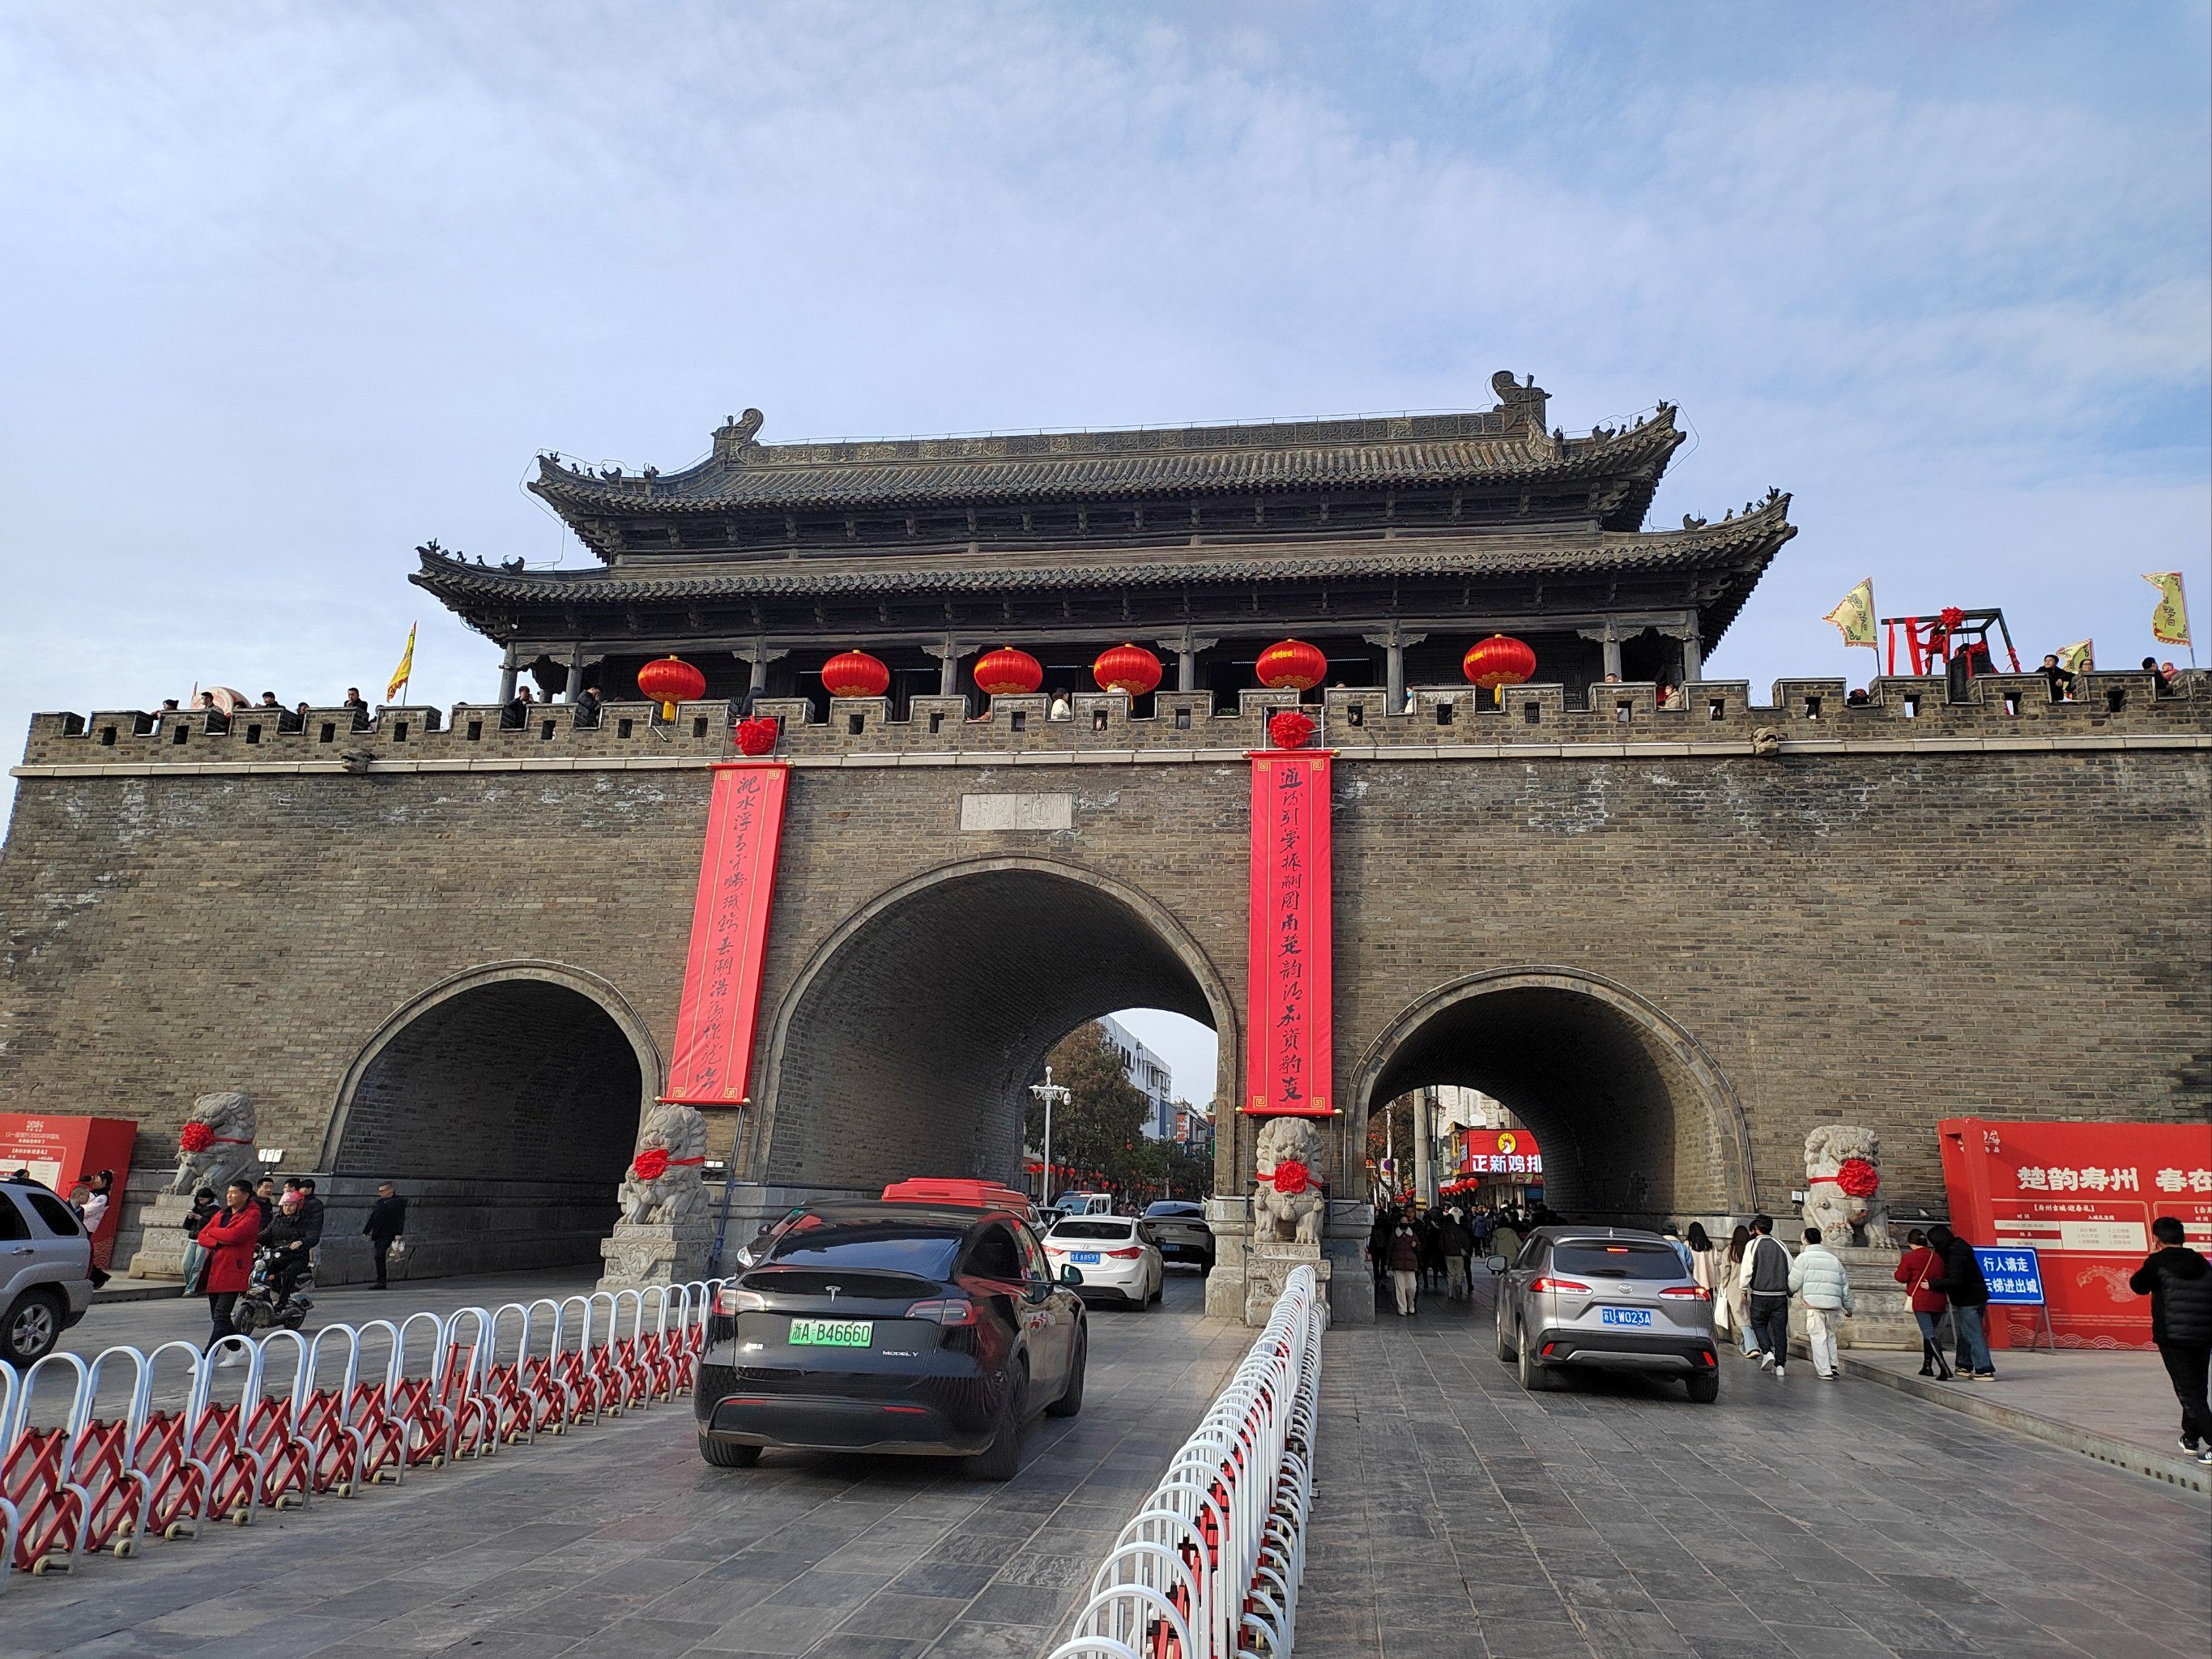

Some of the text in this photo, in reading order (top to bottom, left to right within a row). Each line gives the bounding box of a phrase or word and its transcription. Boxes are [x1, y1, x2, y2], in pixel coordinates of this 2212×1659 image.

[1472, 1154, 1542, 1173] 正新鸡排
[2017, 1166, 2140, 1192] 楚韵寿州
[1984, 1256, 2030, 1273] 行人请走
